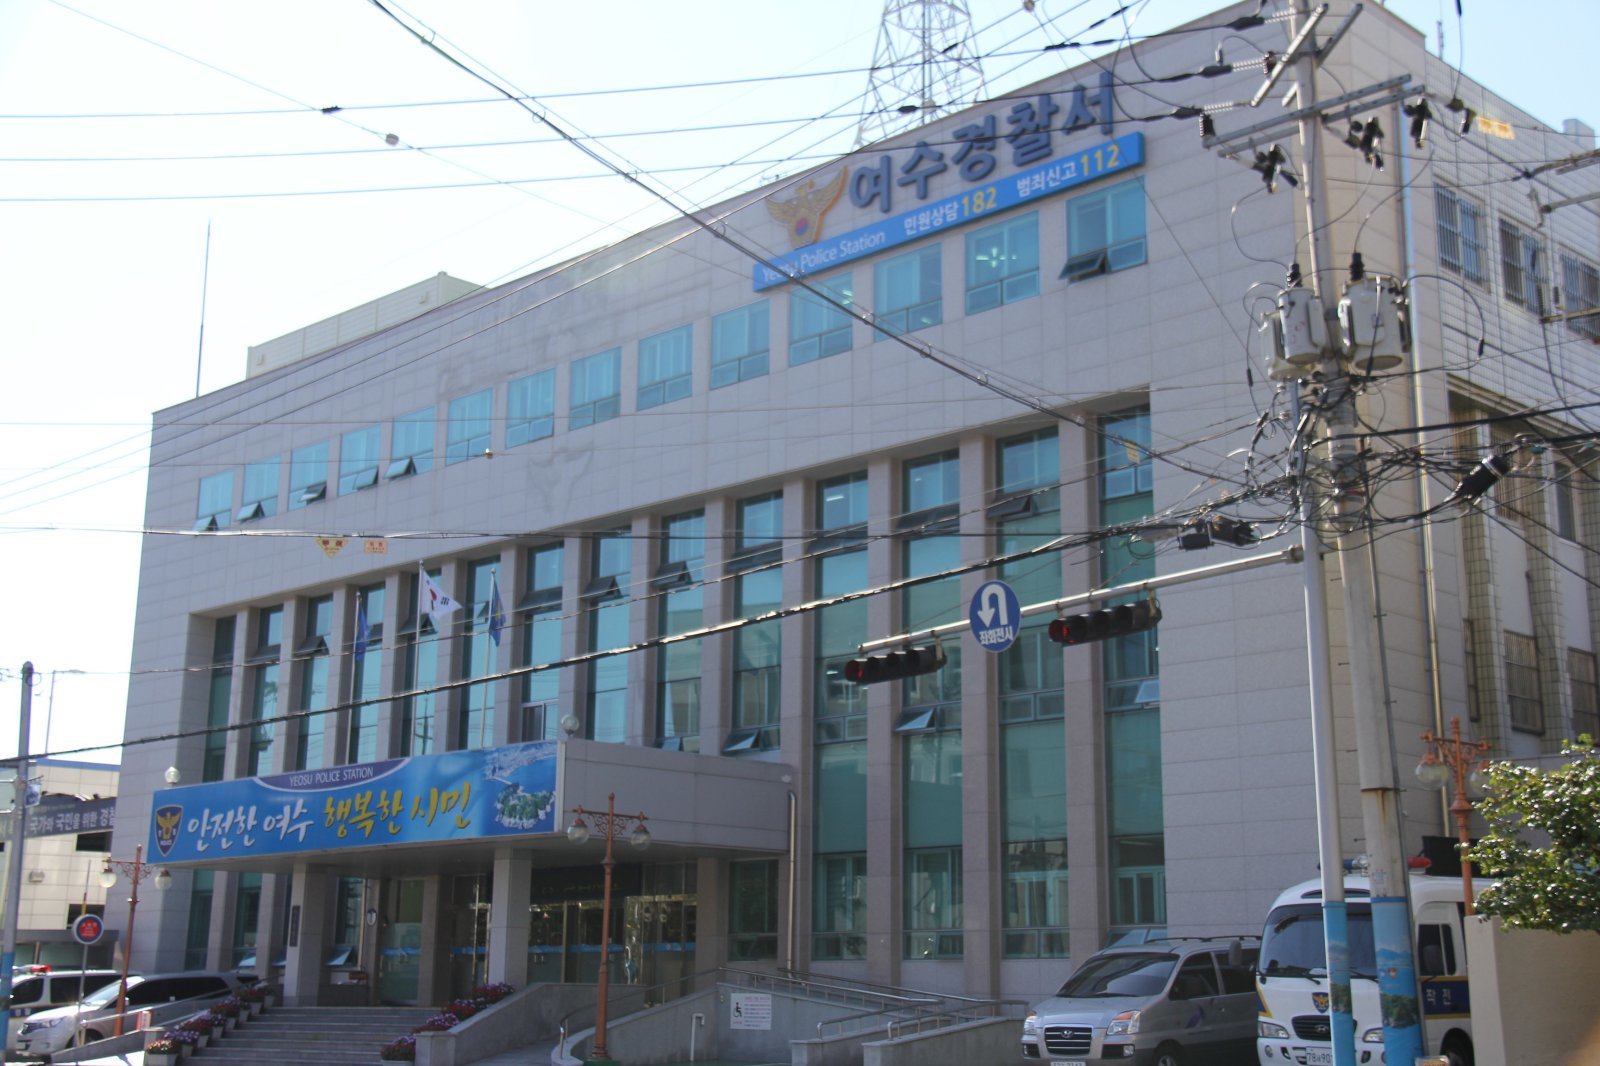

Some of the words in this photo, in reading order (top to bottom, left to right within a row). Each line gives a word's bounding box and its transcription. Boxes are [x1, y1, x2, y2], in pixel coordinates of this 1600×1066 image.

[849, 70, 1115, 213] 여수경찰서
[1017, 161, 1077, 198] 범죄신고
[1080, 144, 1121, 177] 112
[904, 201, 959, 236] 민원상담
[961, 186, 998, 217] 182
[801, 247, 837, 270] Police
[840, 232, 886, 257] Station
[290, 775, 313, 787] YEOSU
[316, 770, 341, 784] POLICE
[343, 767, 374, 781] STATION
[56, 812, 80, 832] 국민을
[187, 805, 258, 852] 안전한
[263, 798, 315, 842] 여수
[323, 790, 404, 838] 행복한
[410, 780, 471, 829] 시민
